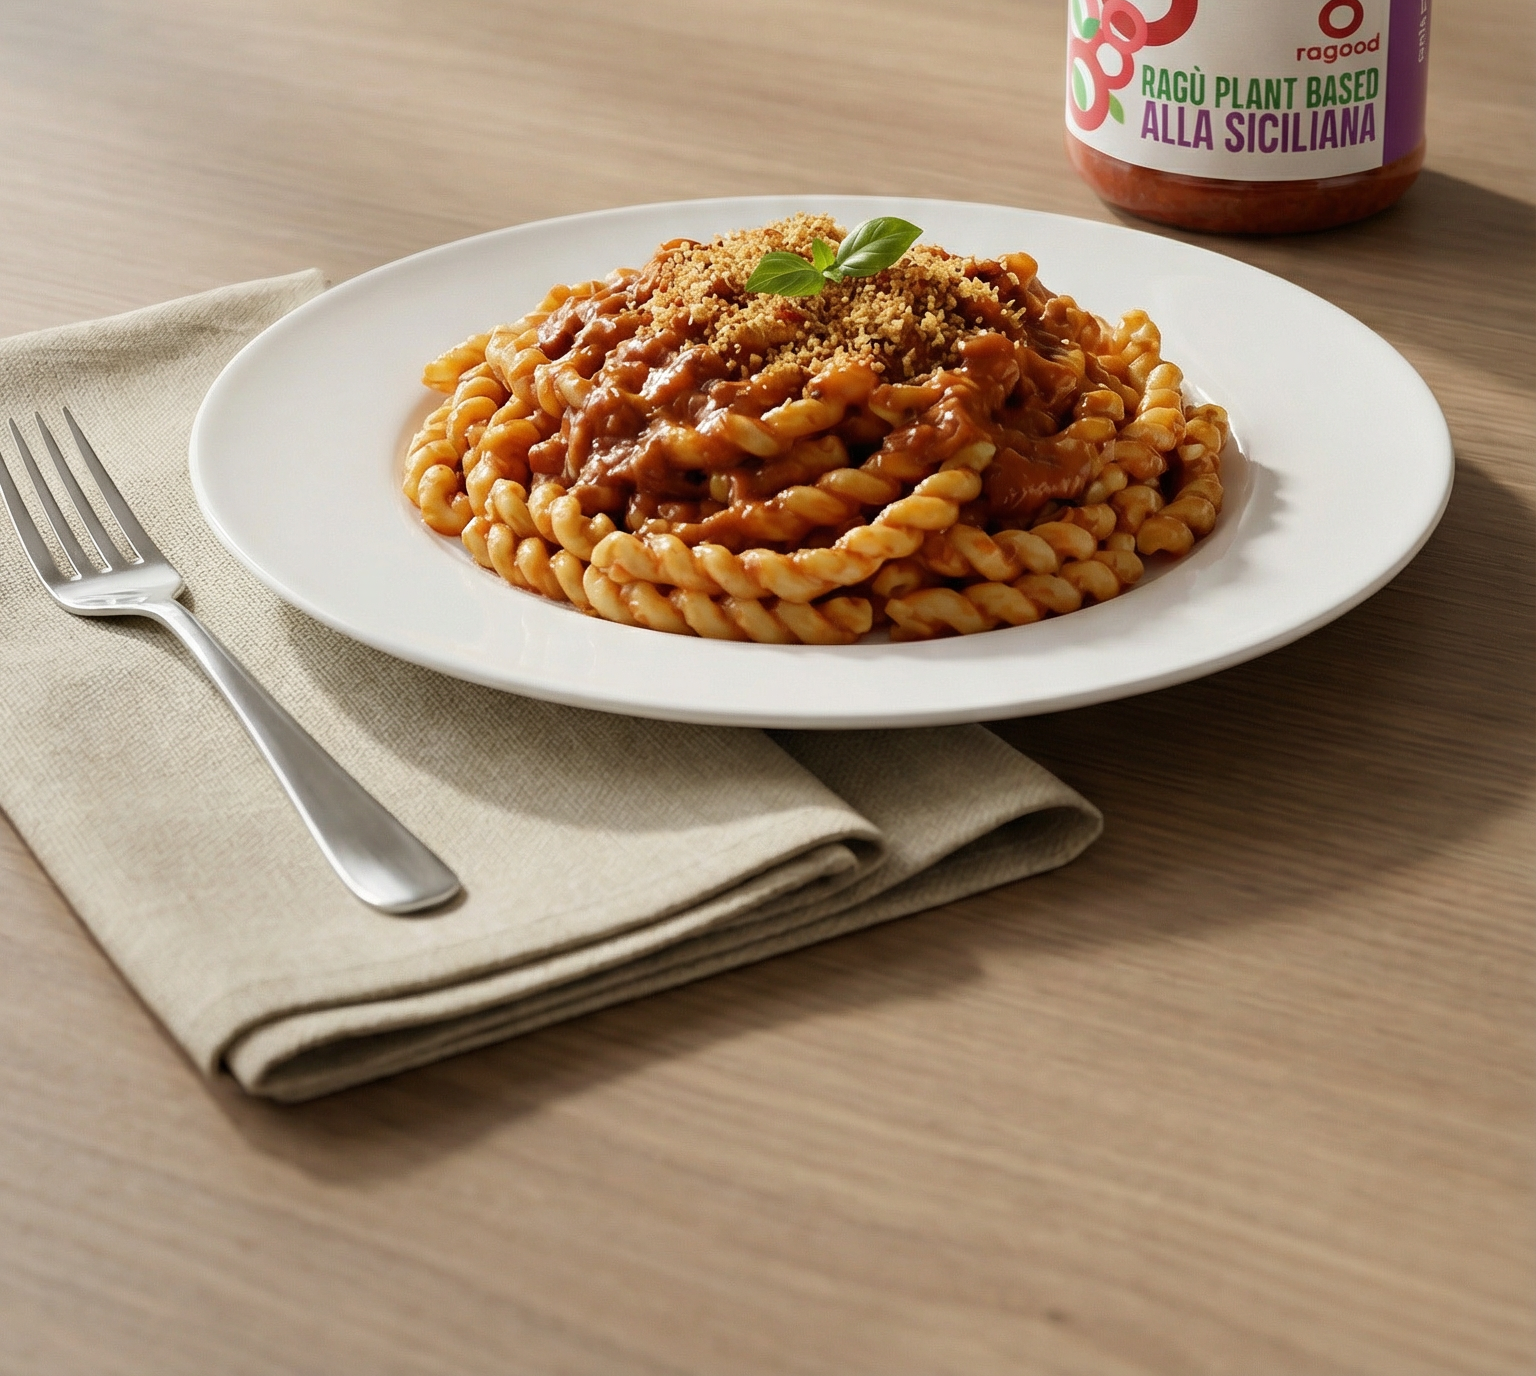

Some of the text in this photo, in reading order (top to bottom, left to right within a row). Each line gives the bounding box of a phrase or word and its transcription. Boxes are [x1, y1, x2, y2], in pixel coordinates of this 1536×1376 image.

[1296, 32, 1380, 63] ragood
[1141, 64, 1379, 110] RAGÙ PLANT BASED
[1140, 100, 1376, 153] ALLA SICILIANA
